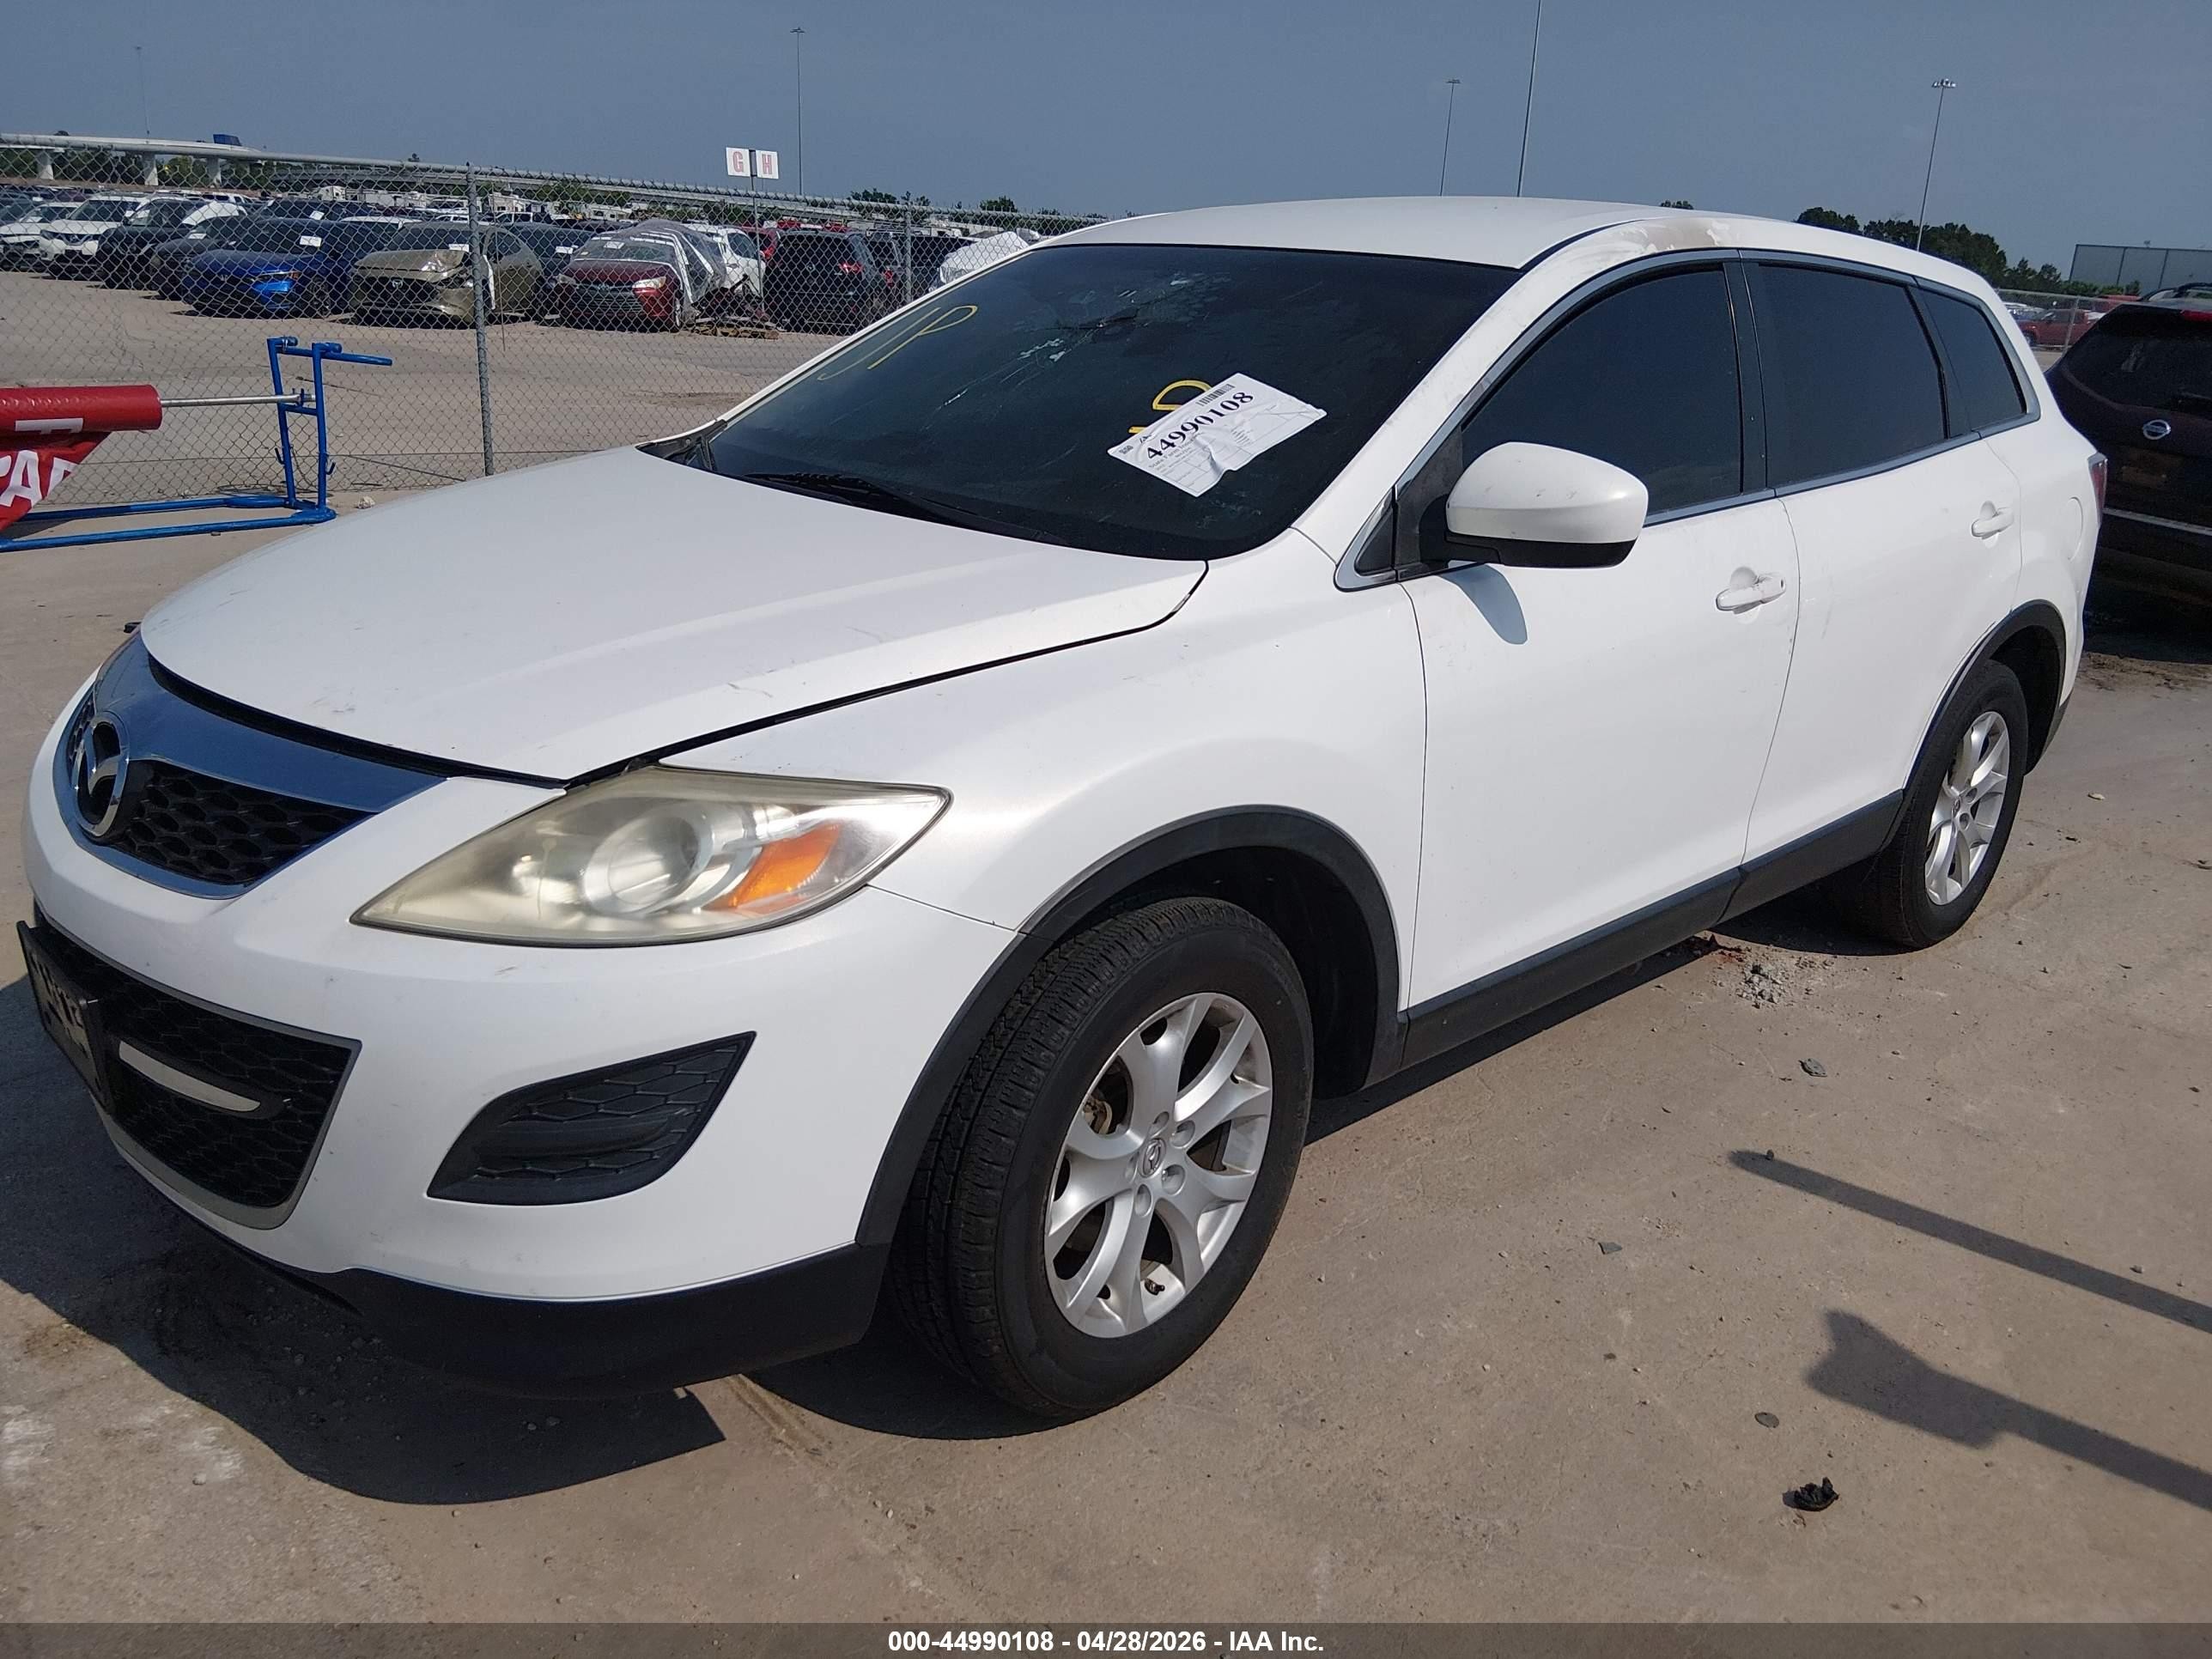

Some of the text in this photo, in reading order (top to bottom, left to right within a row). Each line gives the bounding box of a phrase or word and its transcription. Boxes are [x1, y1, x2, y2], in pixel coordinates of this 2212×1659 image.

[732, 151, 744, 173] G
[762, 154, 773, 175] H
[1147, 392, 1254, 459] 44990108
